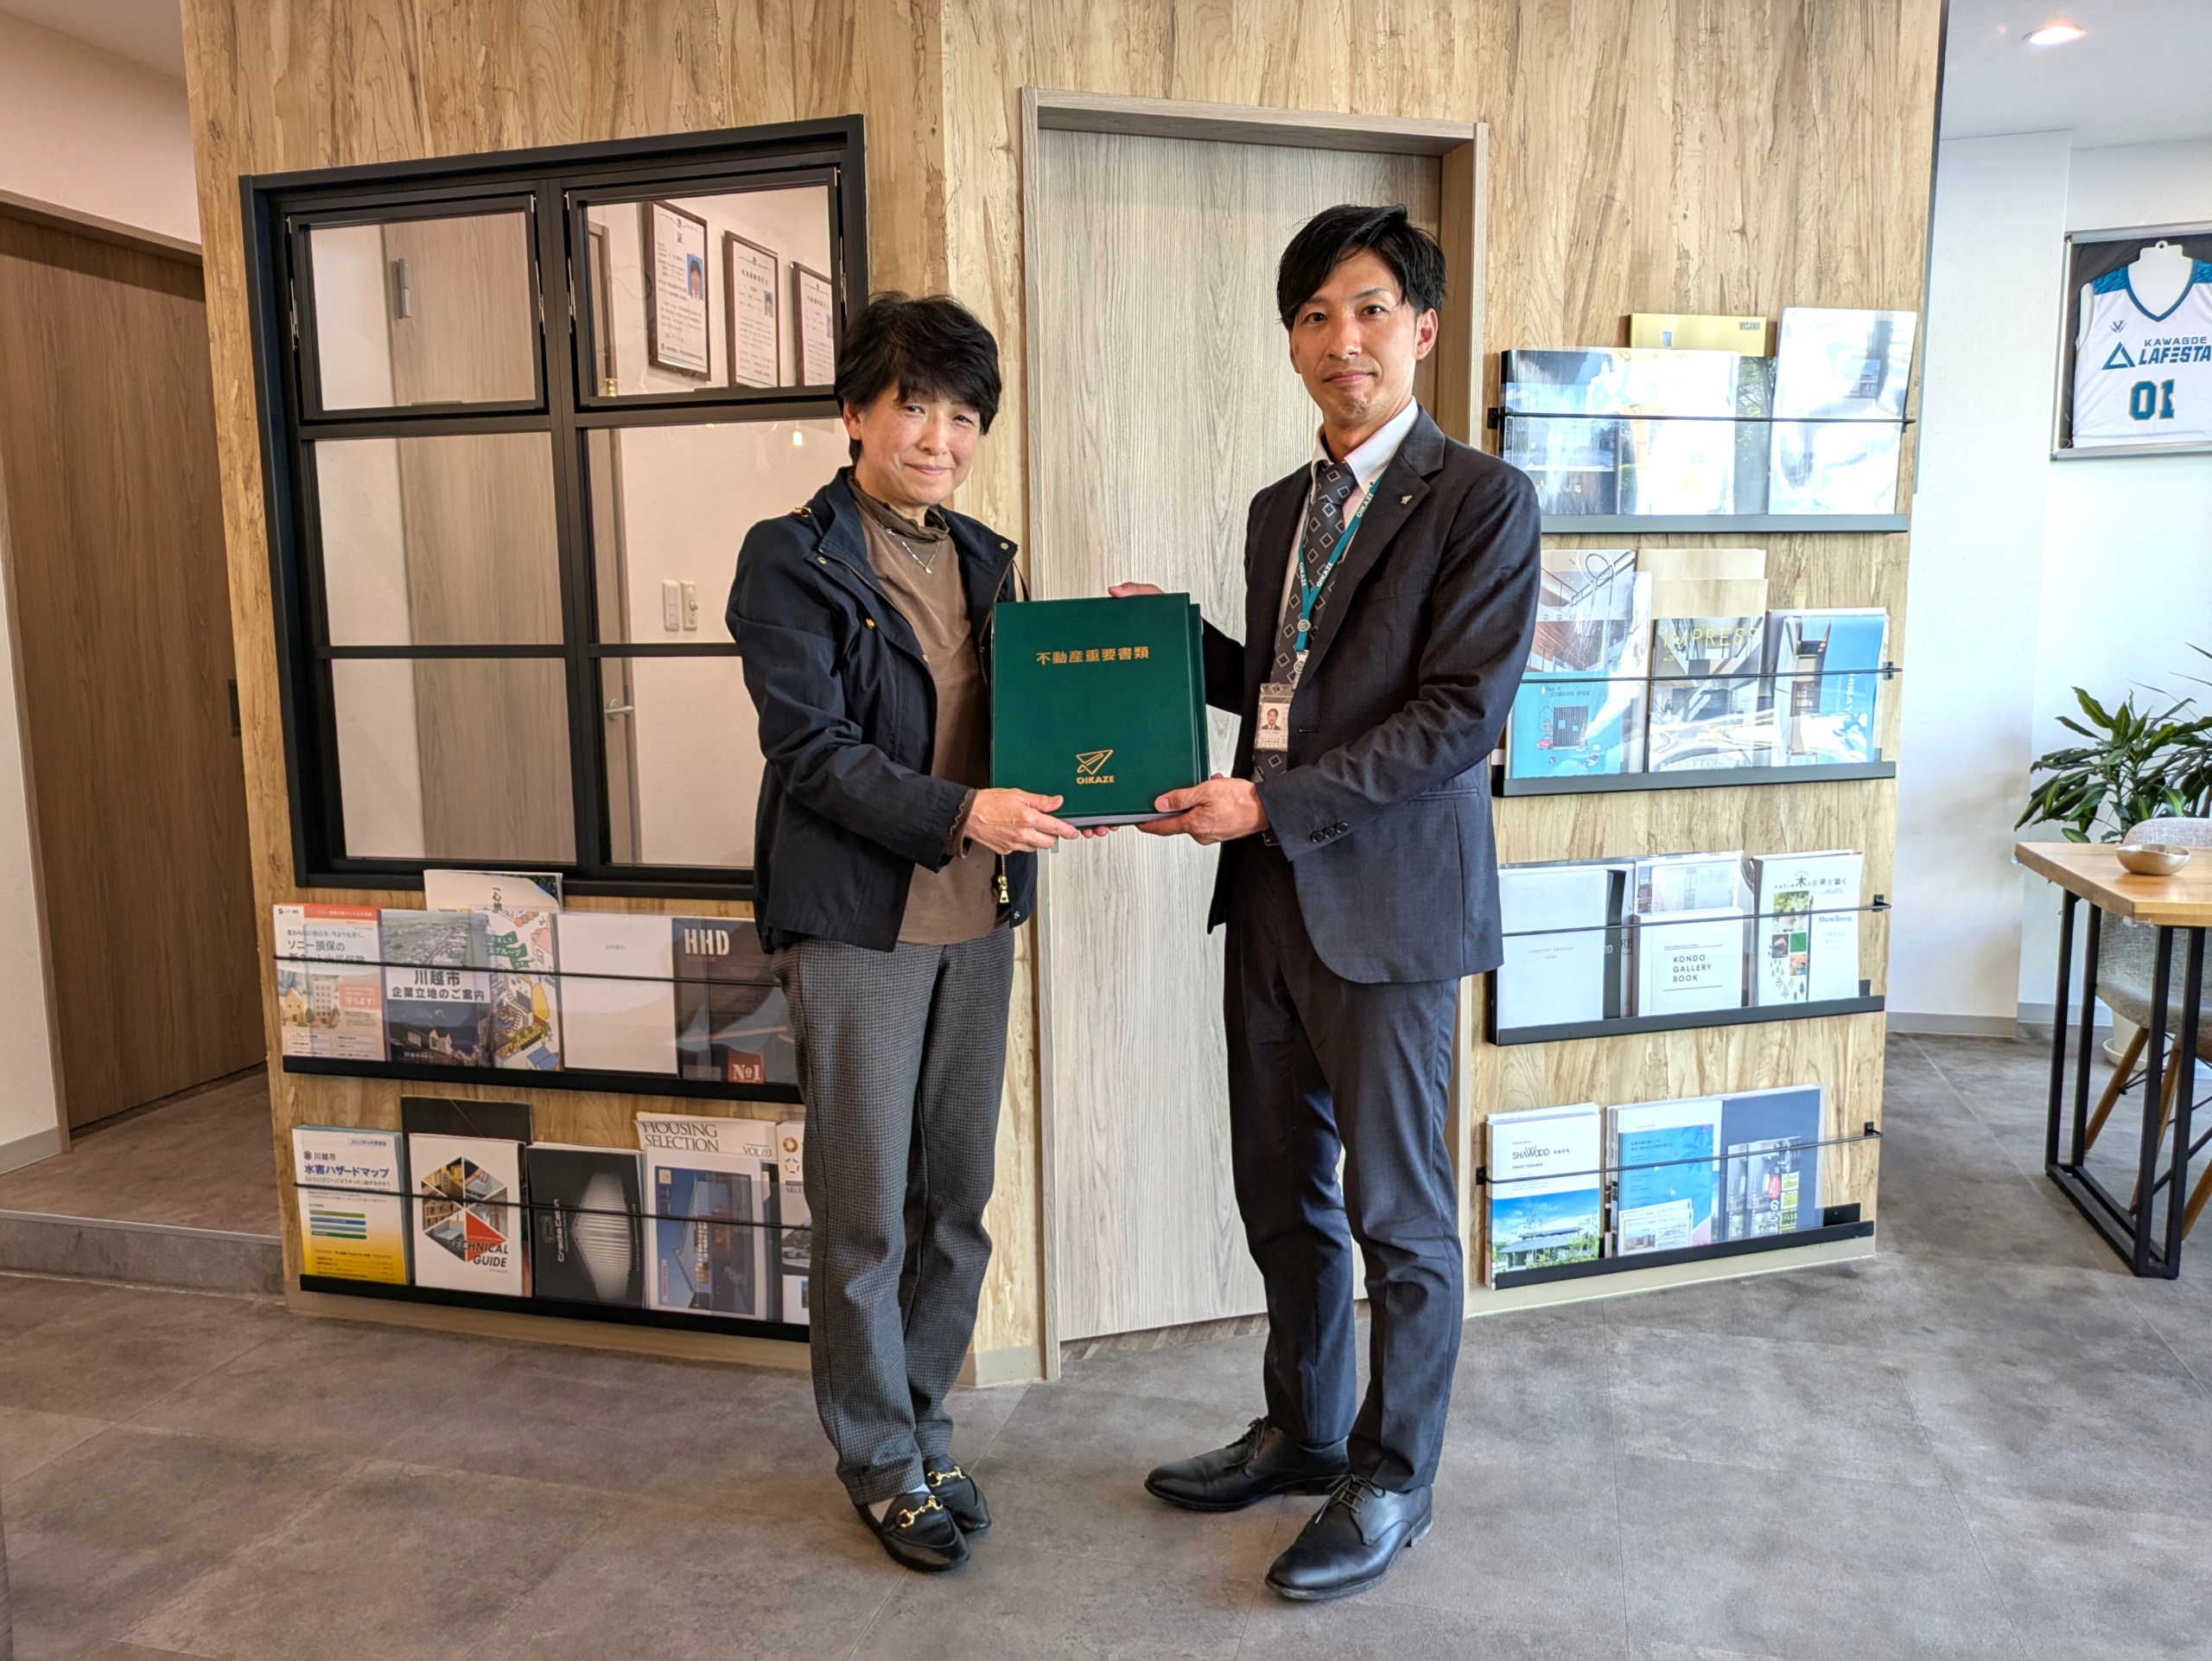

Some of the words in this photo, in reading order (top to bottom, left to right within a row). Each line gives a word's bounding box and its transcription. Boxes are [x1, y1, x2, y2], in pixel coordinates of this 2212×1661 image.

[1738, 321, 1761, 331] MISAWA
[2144, 336, 2208, 347] KAWAGOE
[2138, 345, 2212, 366] LAFESTA
[2128, 379, 2175, 421] 01
[1316, 561, 1333, 588] OIKAZE
[1662, 627, 1758, 647] IMPRESS
[1035, 646, 1150, 665] 不動産重要書類
[1076, 774, 1115, 785] OIKAZE
[288, 939, 345, 951] ソニー損保の
[683, 928, 730, 956] HHD
[1673, 954, 1706, 964] KONDO
[1673, 964, 1712, 973] GALLERY
[414, 969, 461, 986] 川越市
[1673, 974, 1698, 983] BOOK
[391, 986, 485, 1001] 企業立地のご案内
[643, 1122, 718, 1138] HOUSING
[645, 1134, 720, 1153] SELECTION
[314, 1151, 336, 1161] 川越市
[304, 1163, 390, 1178] 水害ハザードマップ
[448, 1238, 509, 1255] TECHNICAL
[473, 1254, 507, 1268] GUIDE
